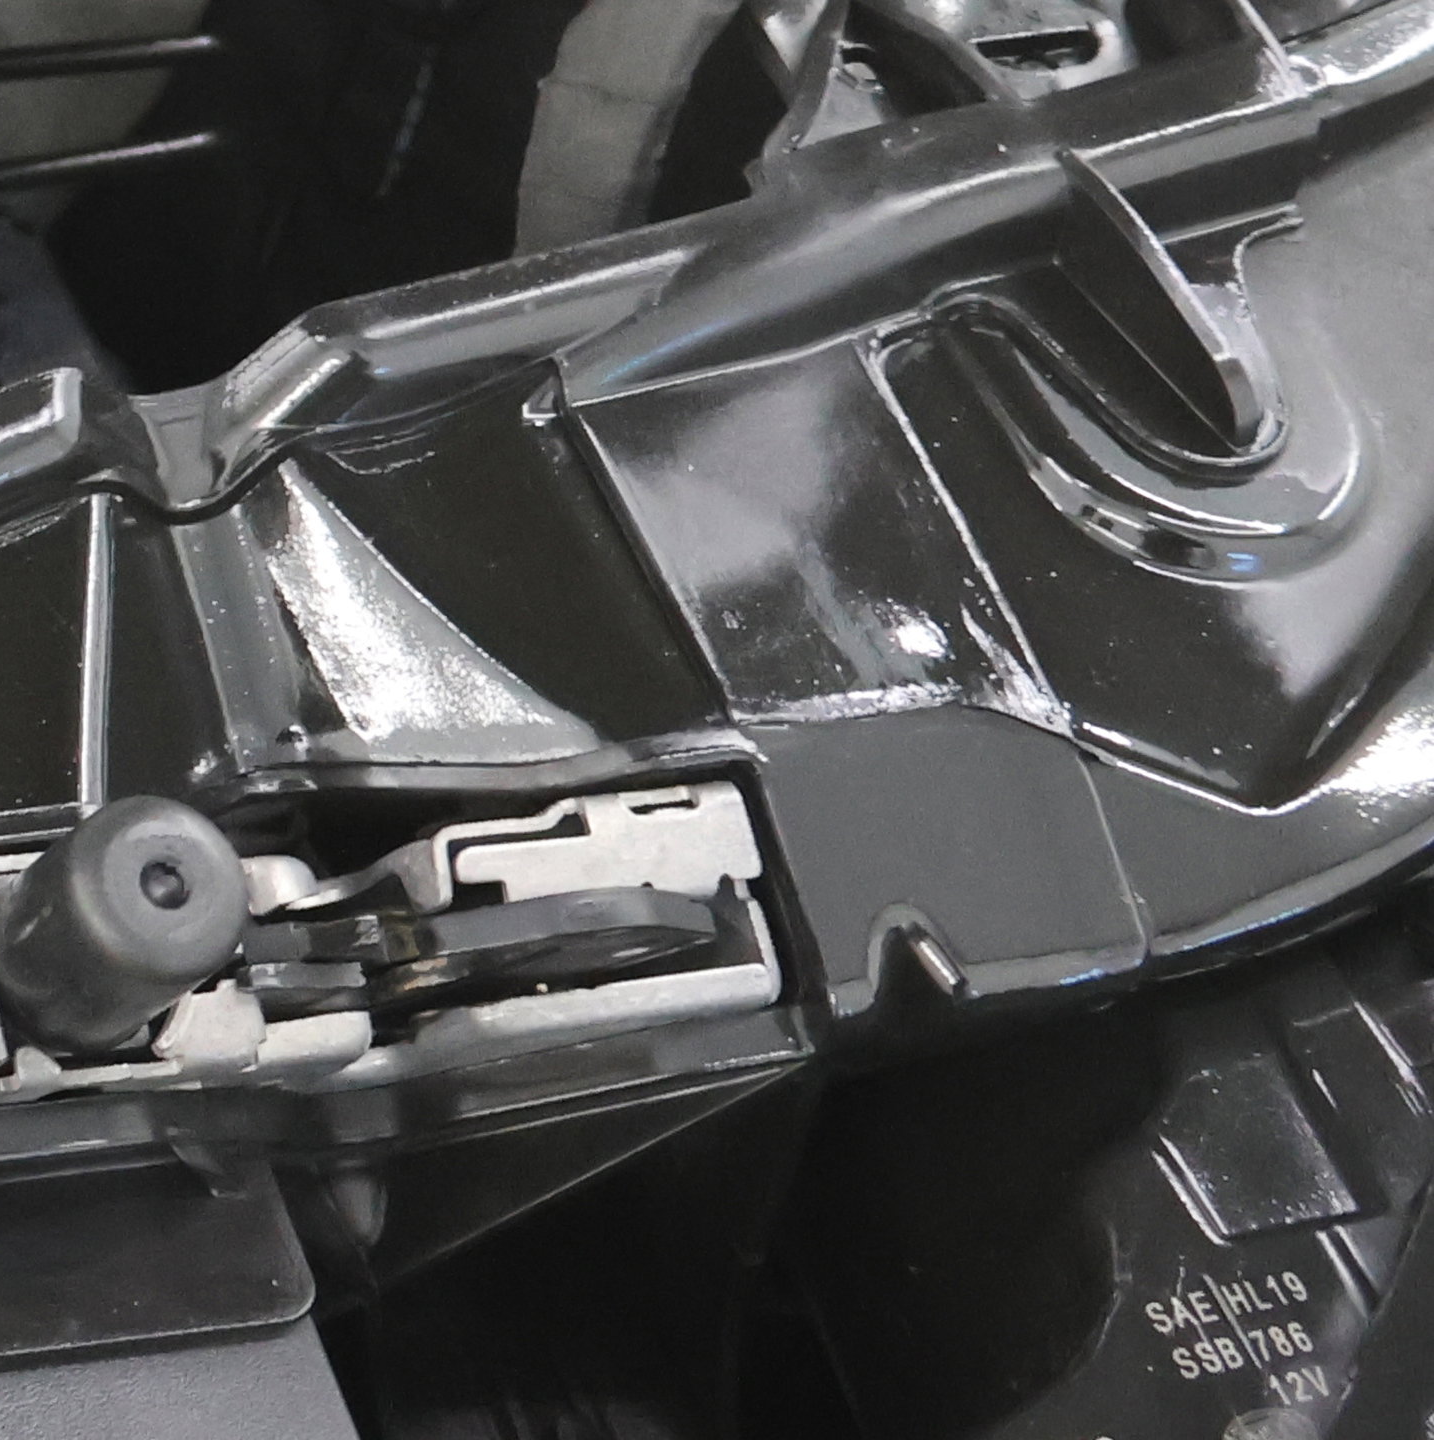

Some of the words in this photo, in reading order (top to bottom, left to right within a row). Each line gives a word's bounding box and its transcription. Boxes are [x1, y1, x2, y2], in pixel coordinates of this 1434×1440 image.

[1144, 1290, 1220, 1334] SAE
[1220, 1271, 1308, 1316] HL19
[1172, 1336, 1244, 1380] SSB
[1247, 1320, 1314, 1362] 786
[1269, 1365, 1330, 1406] 12V
